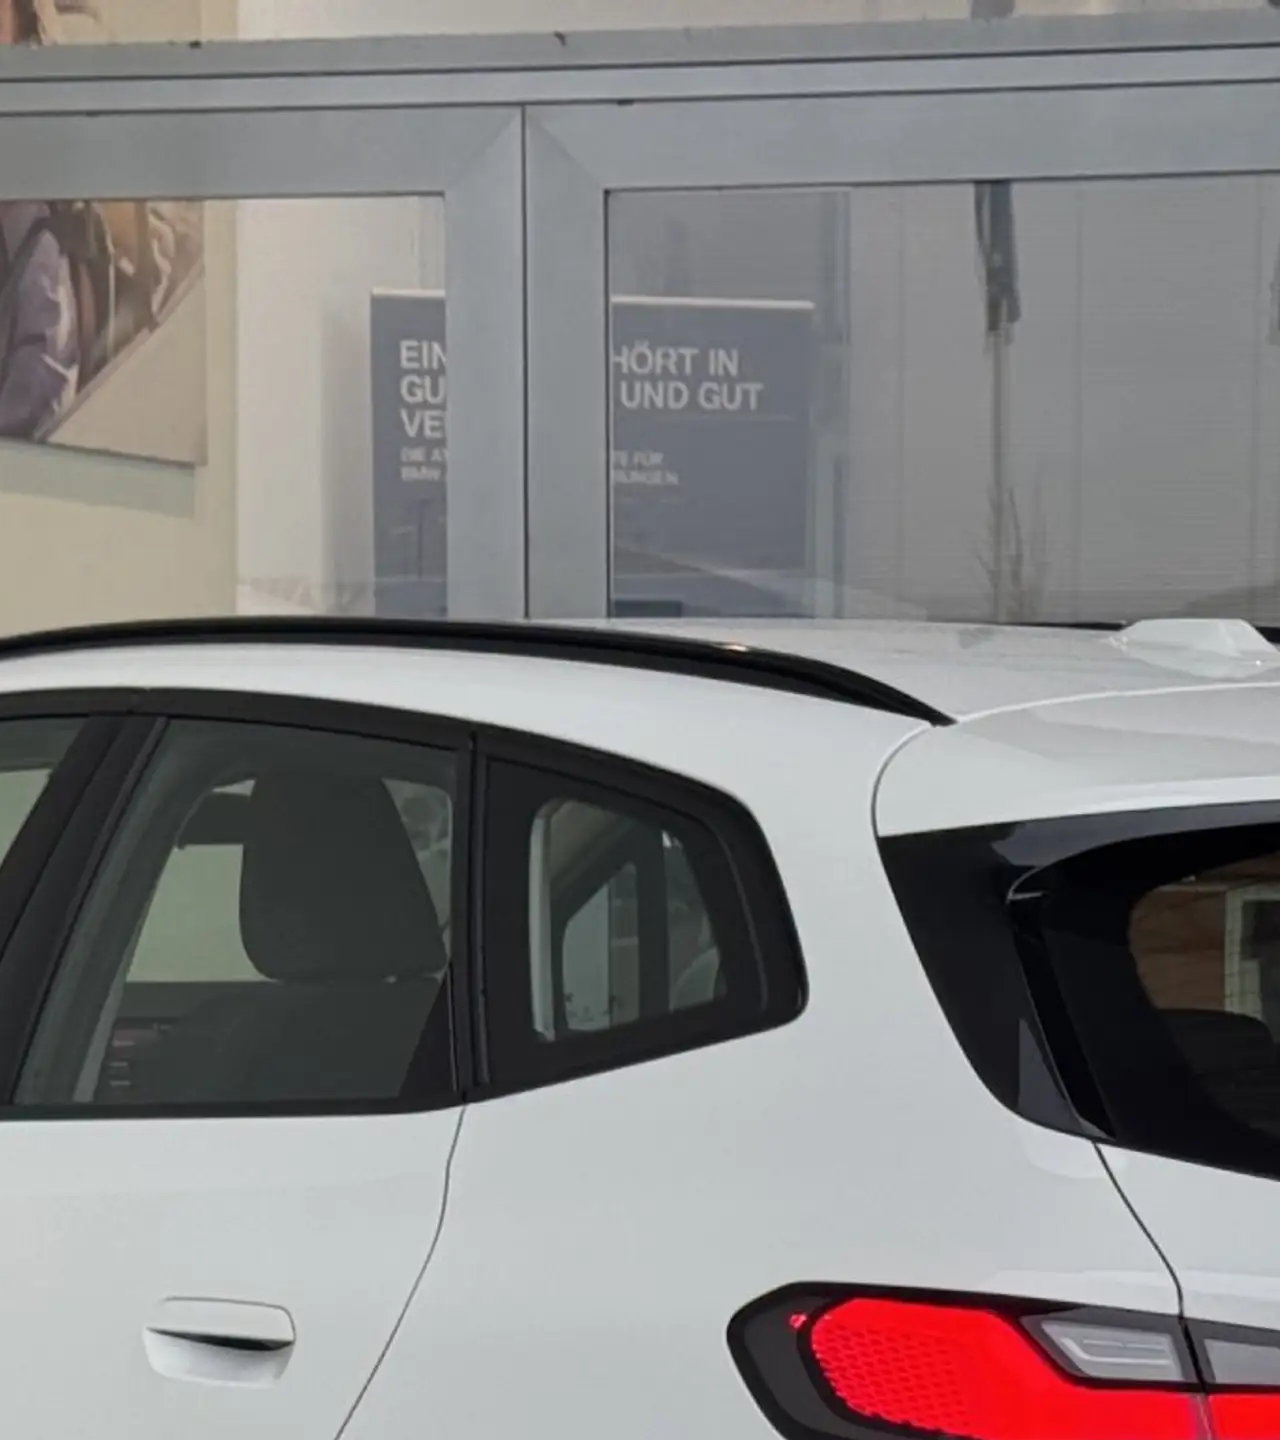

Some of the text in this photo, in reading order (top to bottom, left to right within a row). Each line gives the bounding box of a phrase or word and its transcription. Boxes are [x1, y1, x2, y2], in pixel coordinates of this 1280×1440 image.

[708, 347, 739, 377] IN
[620, 381, 690, 410] UND
[698, 382, 765, 411] GUT
